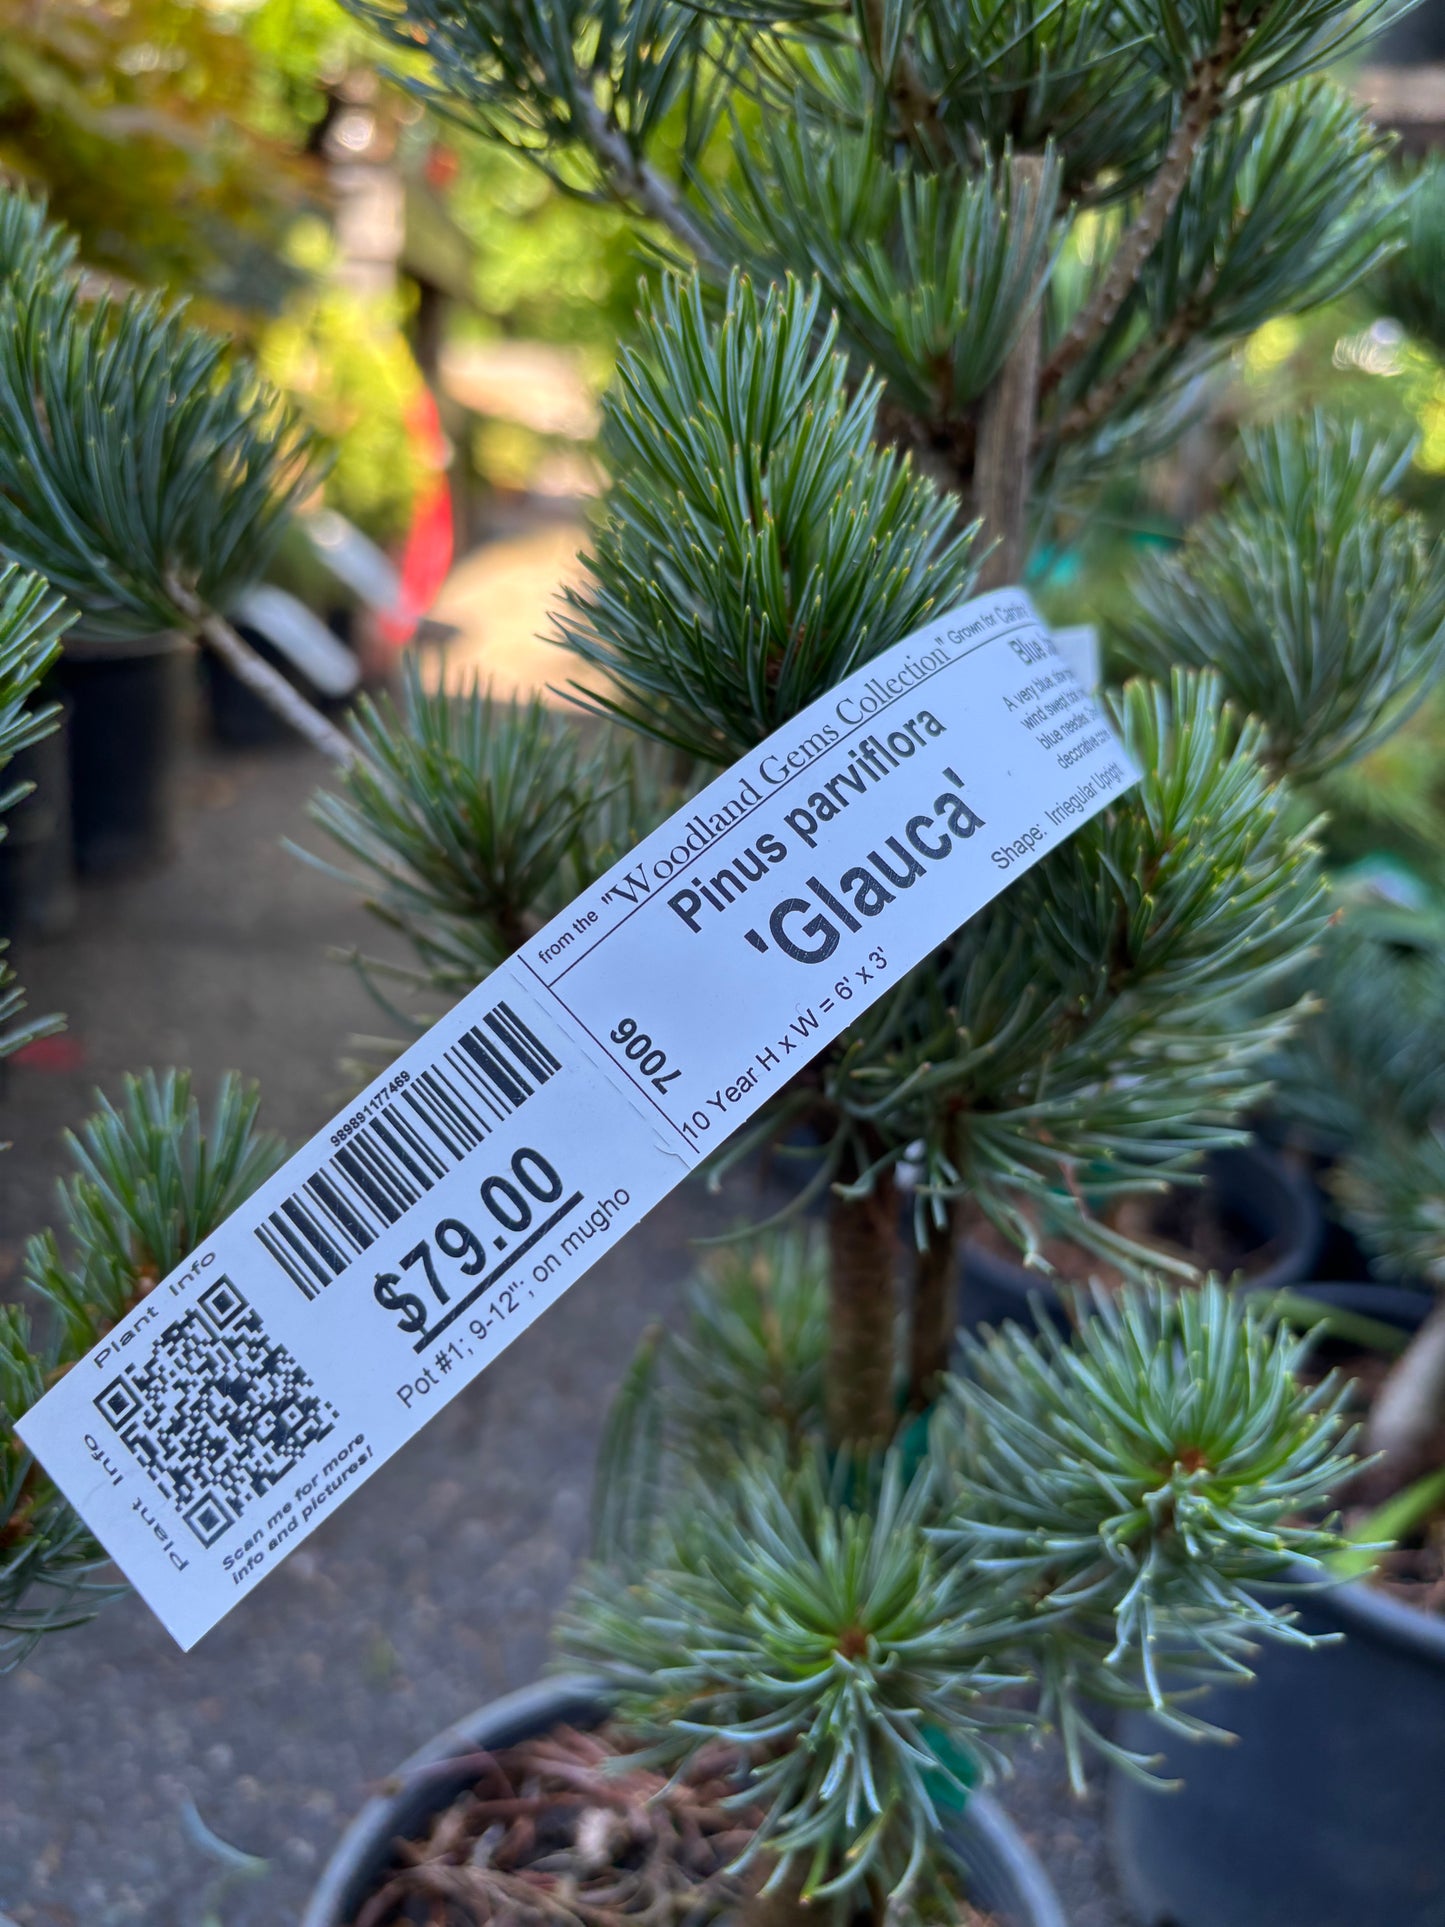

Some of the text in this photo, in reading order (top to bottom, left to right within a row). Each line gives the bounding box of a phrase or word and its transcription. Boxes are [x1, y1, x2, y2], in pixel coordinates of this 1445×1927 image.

[1002, 696, 1017, 712] A
[1014, 685, 1040, 705] very
[1008, 638, 1048, 665] Blue
[1020, 708, 1048, 730] wind
[1049, 695, 1071, 716] swept
[538, 614, 997, 964] from the "Woodland Gems Collection" Grown for
[1036, 730, 1063, 750] blue
[1056, 735, 1100, 769] decorative
[667, 710, 947, 934] Pinus parviflora
[744, 767, 986, 964] 'Glauca'
[991, 824, 1048, 869] Shape:
[1090, 761, 1124, 789] Upright
[610, 1018, 682, 1095] 7006
[682, 946, 888, 1139] 10 Year H x W = 6' x 3'
[330, 1071, 410, 1146] 989891177469
[373, 1147, 563, 1337] $79.00
[396, 1189, 630, 1409] Pot #1; 9-12"; on mugho
[94, 1252, 216, 1369] Plant Info
[84, 1434, 190, 1571] Plant Info
[222, 1433, 365, 1570] Scan me for more
[232, 1445, 373, 1584] info and pictures!
